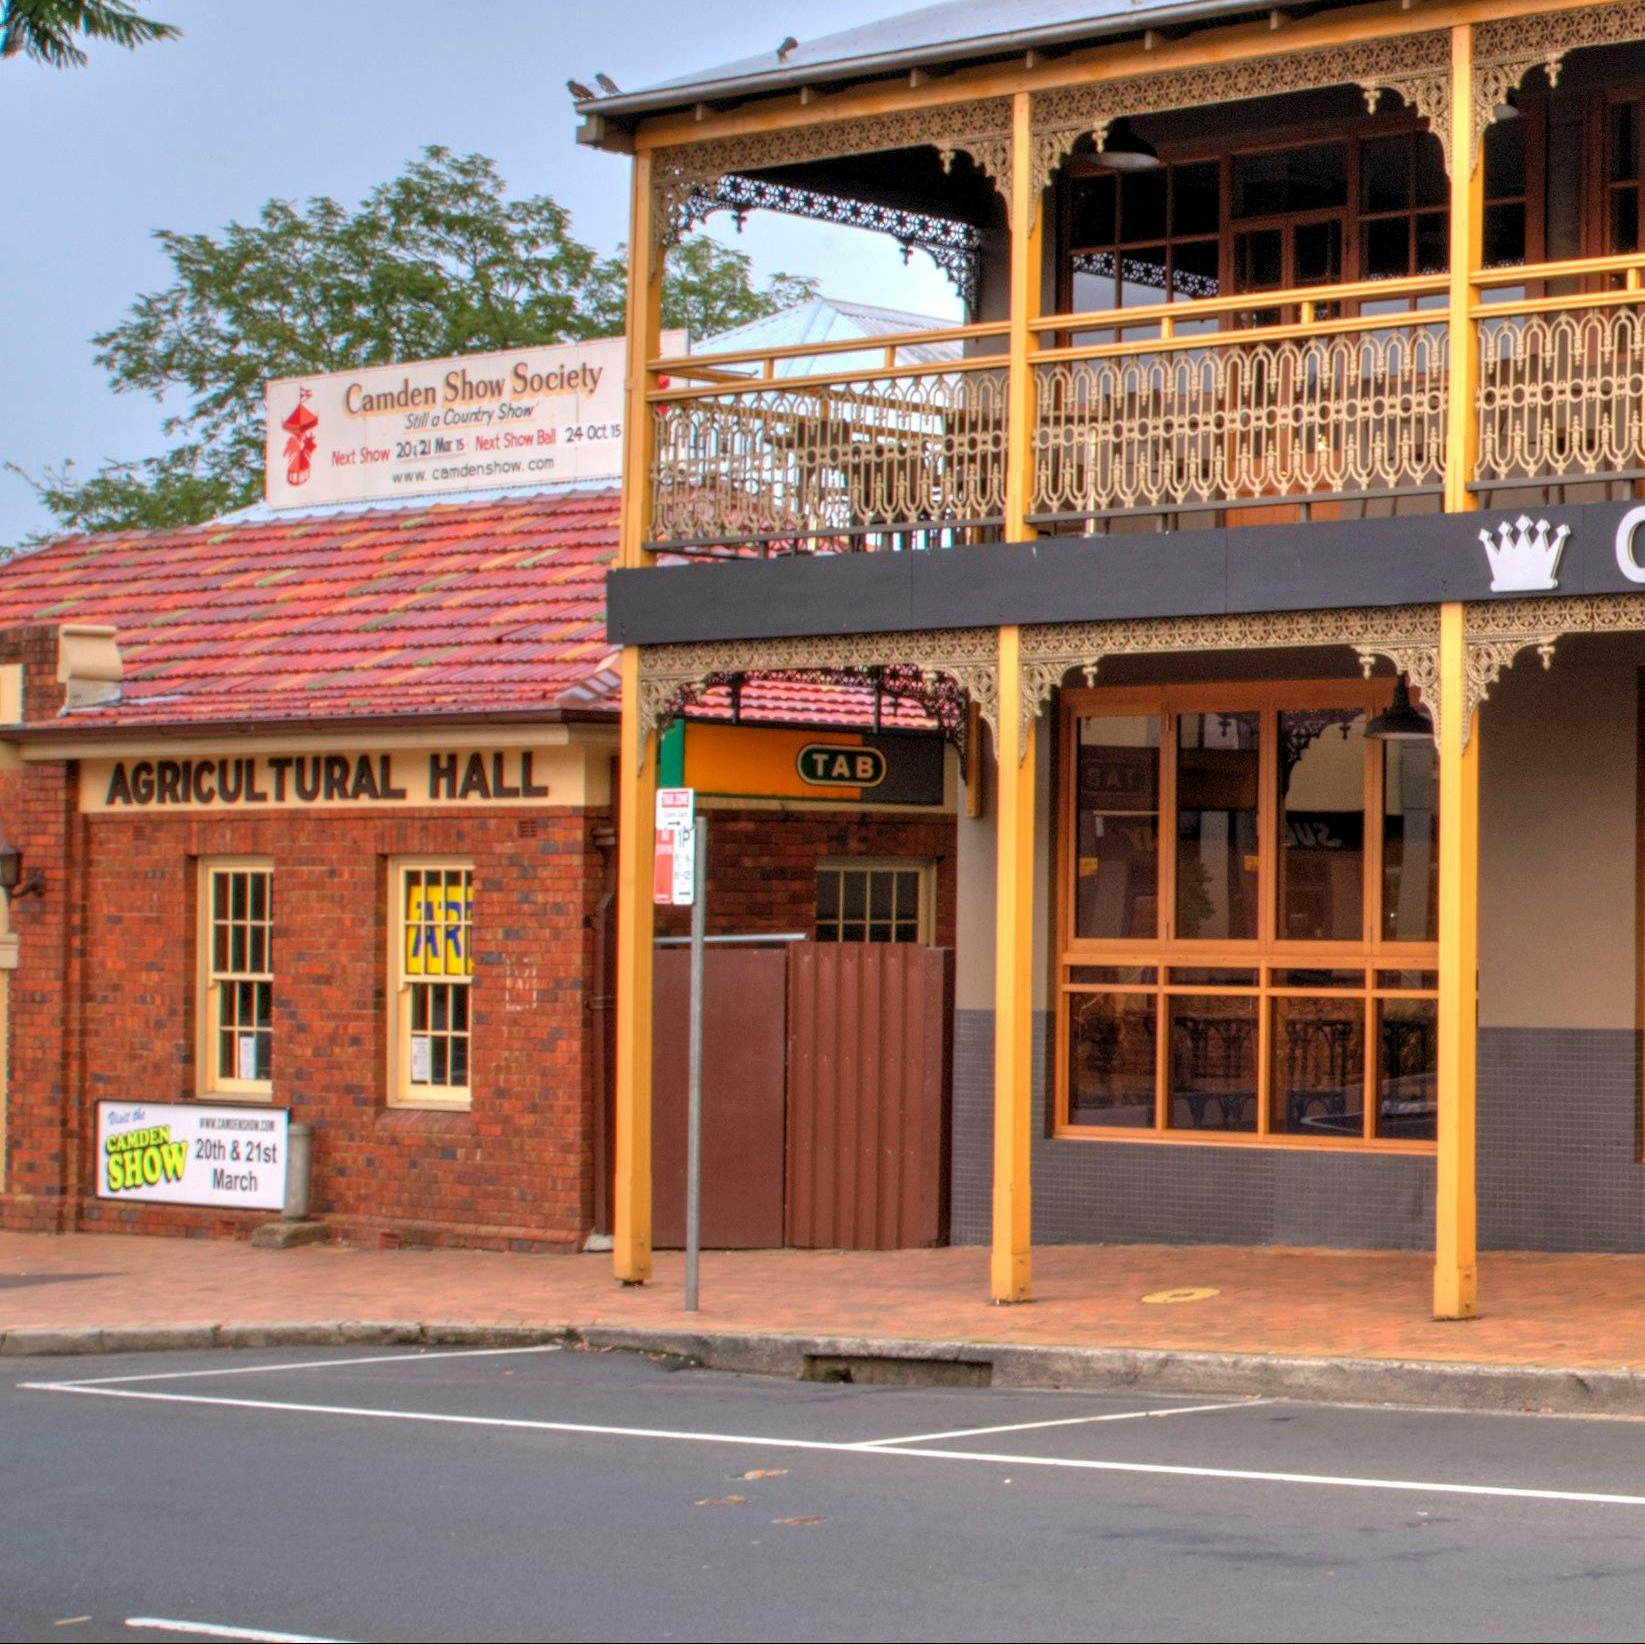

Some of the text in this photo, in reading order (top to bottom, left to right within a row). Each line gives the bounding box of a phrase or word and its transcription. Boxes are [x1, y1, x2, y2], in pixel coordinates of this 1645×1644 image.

[346, 362, 602, 415] Camden Show Society
[432, 415, 441, 427] a
[443, 406, 495, 428] Country
[332, 450, 356, 466] Next
[360, 447, 390, 464] Show
[435, 437, 453, 454] Mar
[475, 436, 500, 452] Next
[504, 431, 534, 448] Show
[537, 428, 556, 446] Ball
[565, 427, 584, 444] 24
[587, 424, 607, 441] Oct
[610, 424, 622, 438] 15
[105, 750, 549, 805] AGRICULTURAL HALL
[813, 753, 874, 779] TAB
[199, 1117, 275, 1132] WWW.CAMDENSHOW.COM
[106, 1125, 171, 1154] CAMDEN
[195, 1138, 277, 1163] 20th & 21st
[107, 1141, 189, 1192] SHOW
[213, 1168, 258, 1192] March
